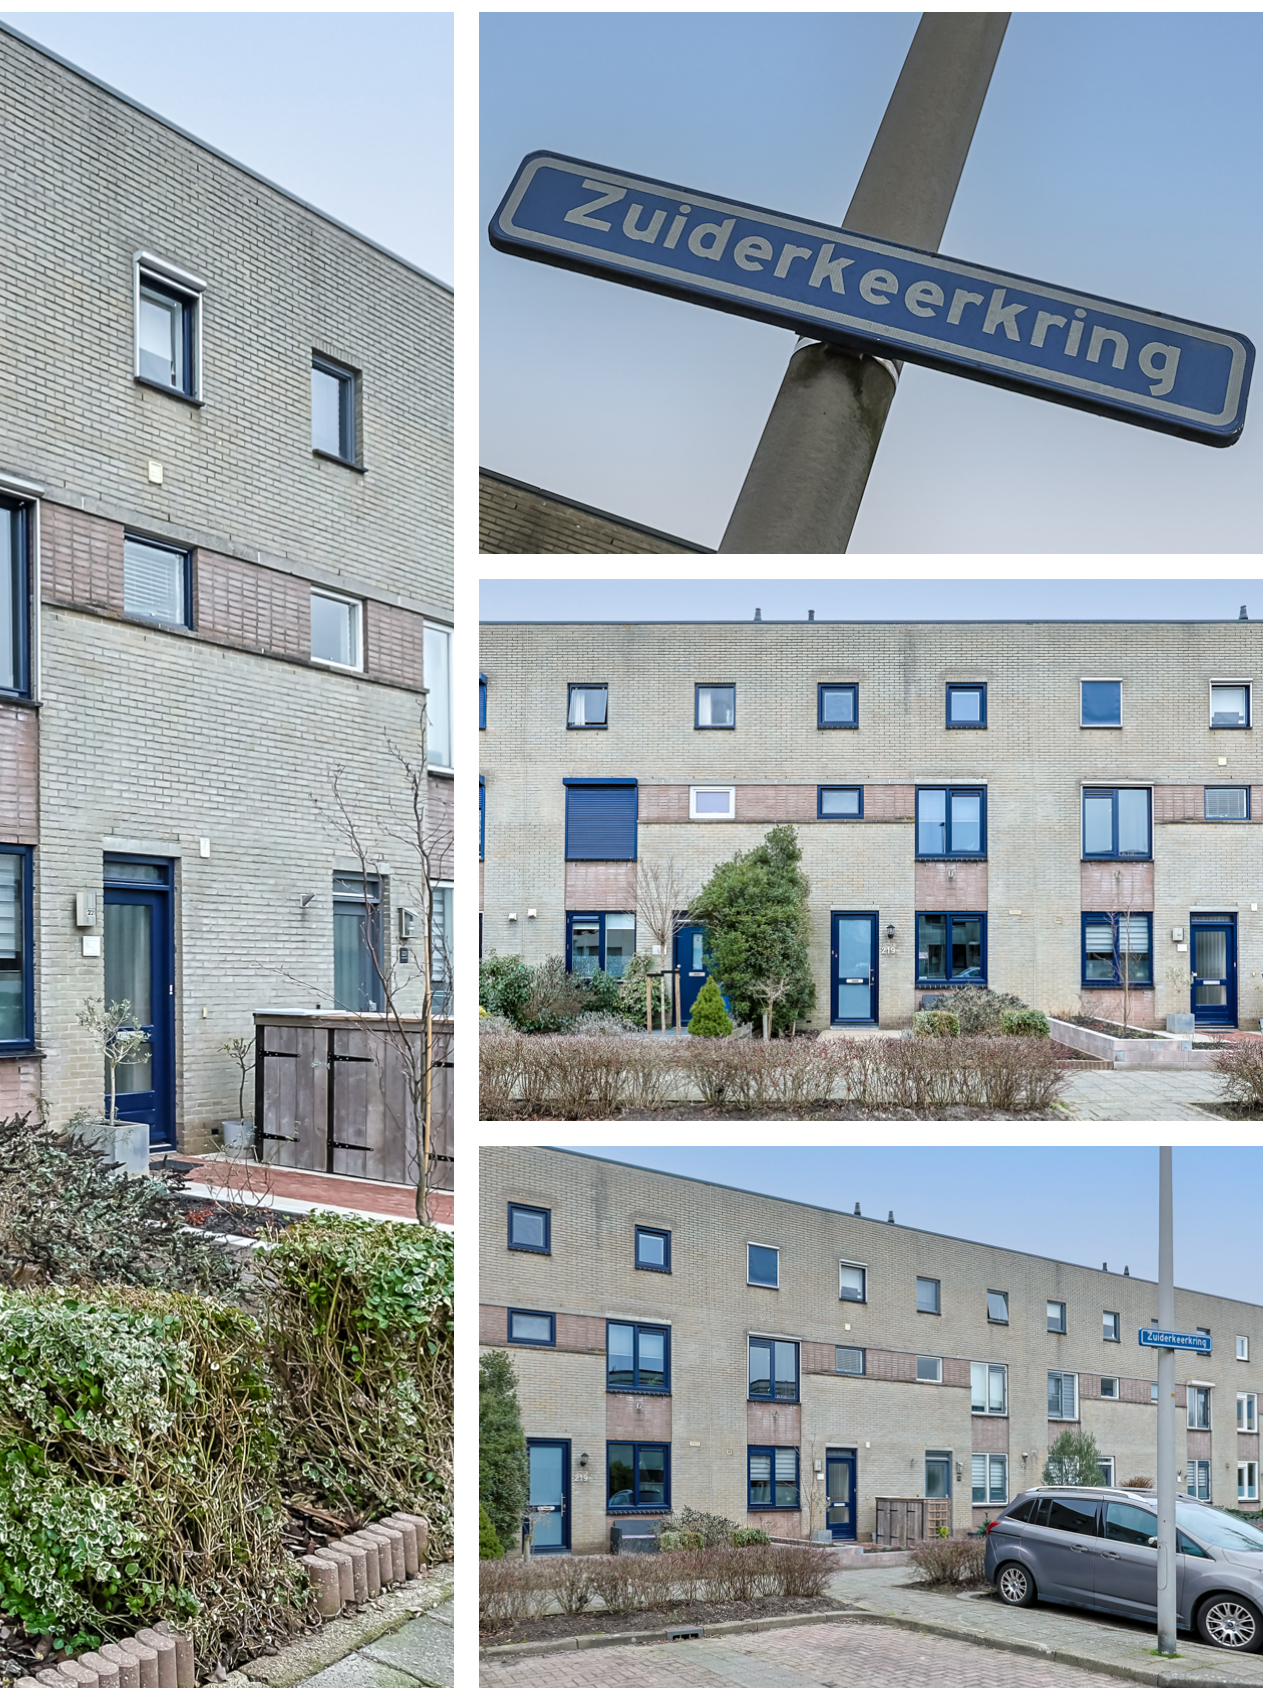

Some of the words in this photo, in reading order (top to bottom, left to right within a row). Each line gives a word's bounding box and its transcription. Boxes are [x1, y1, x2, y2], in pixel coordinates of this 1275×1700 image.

[563, 178, 1182, 397] Zuiderkeerkring
[881, 946, 896, 954] 219
[1147, 1331, 1207, 1349] Zuiderkeerkring
[574, 1474, 589, 1482] 219
